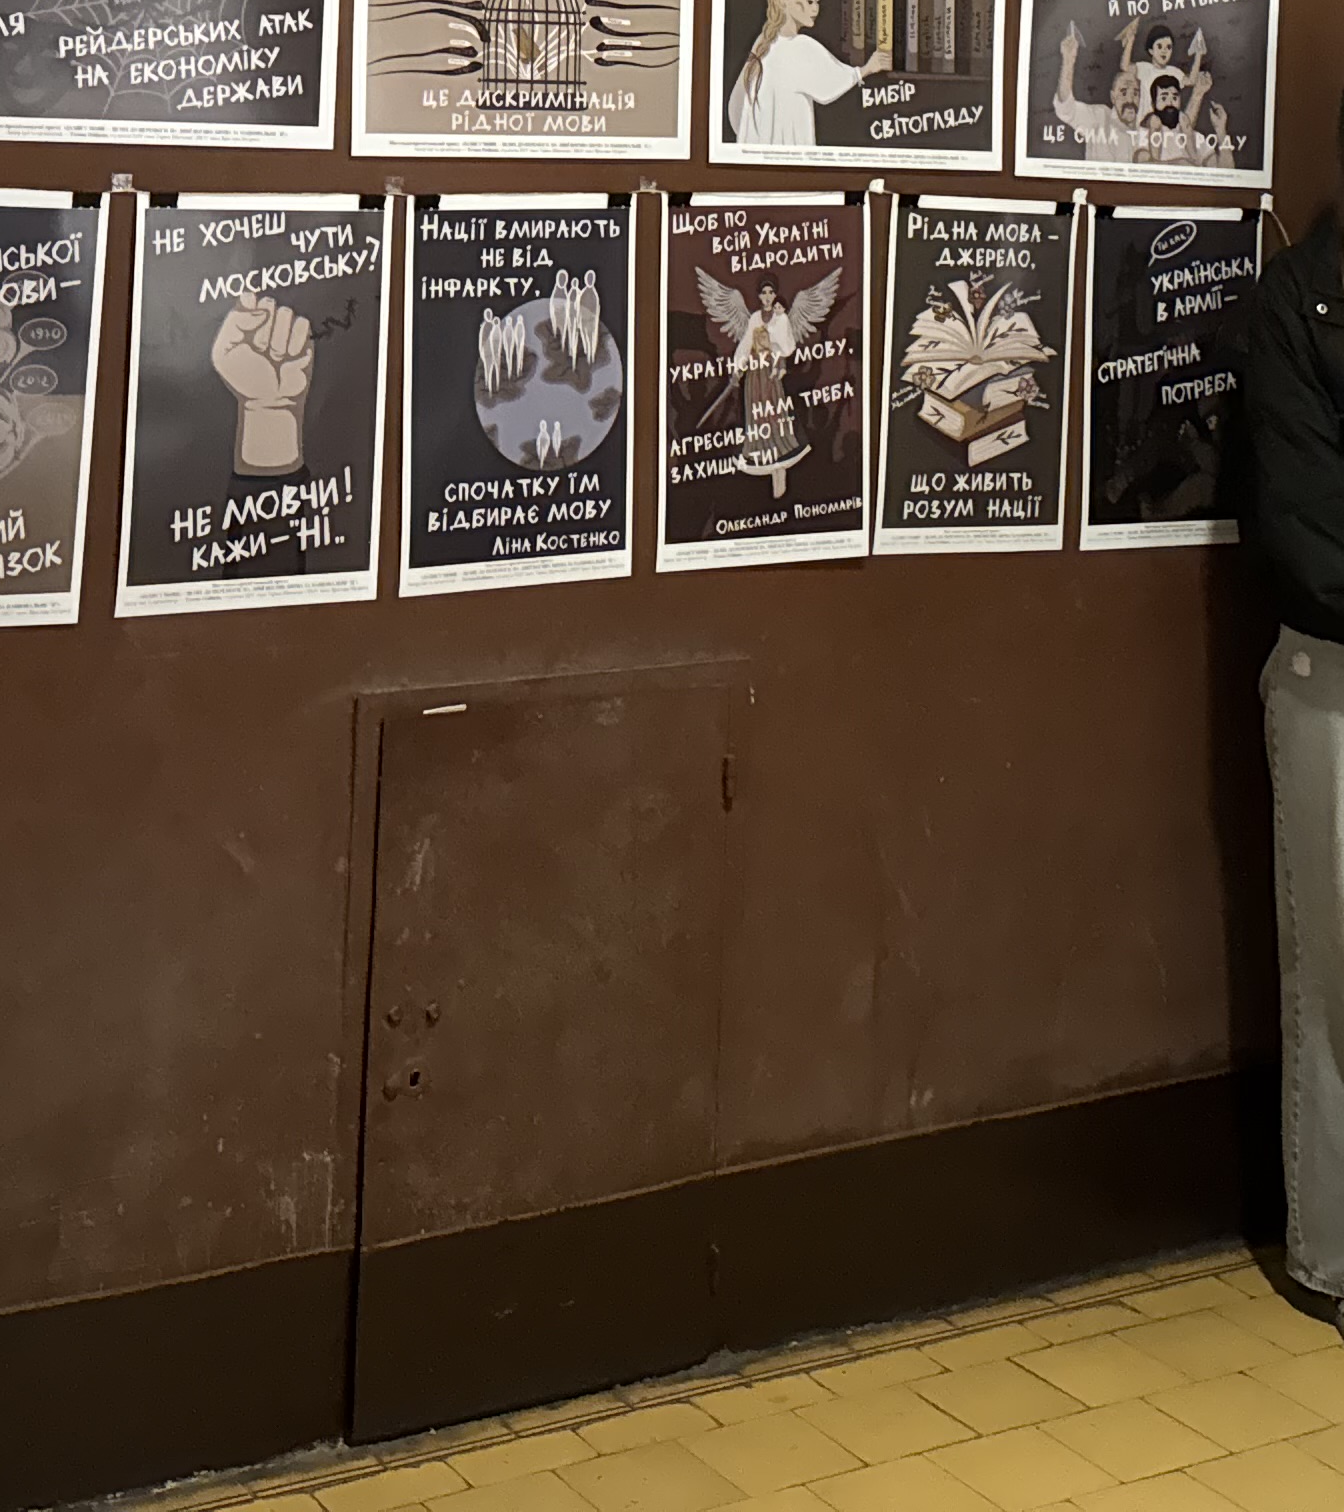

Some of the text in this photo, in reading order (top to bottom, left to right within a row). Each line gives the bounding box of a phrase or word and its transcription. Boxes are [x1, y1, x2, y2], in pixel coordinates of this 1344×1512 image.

[57, 8, 314, 60] РЕЙДЕРСЬКИХ АТАК
[129, 44, 280, 85] ЕКОНОМІКУ
[175, 75, 304, 111] ДЕРЖАВИ
[455, 89, 635, 110] ДИСКРИМІНАЦІЯ
[861, 82, 916, 108] ВИБІР
[451, 110, 607, 132] РІДНОЇ МОВИ
[869, 105, 983, 140] СВІТОГЛЯДУ
[1043, 125, 1247, 151] ЦЕ СИЛА ТВОГО РОДУ
[199, 212, 354, 253] ХОЧЕШ ЧУТИ
[495, 218, 621, 240] ВМИРАЮТЬ
[725, 211, 748, 228] ПО
[985, 222, 1042, 242] МОВА
[512, 244, 554, 268] ВІД
[712, 228, 751, 254] ВСІЙ
[730, 241, 843, 274] ВІДРОДИТИ
[198, 236, 381, 303] МОСКОВСЬКУ?
[1151, 256, 1255, 295] УКРАЇНСЬКА
[1173, 285, 1223, 318] АРМІЇ
[670, 351, 781, 384] УКРАЇНСЬКУ
[1097, 342, 1201, 384] СТРАТЕГІЧНА
[752, 381, 854, 420] НАМ ТРЕБА
[1162, 371, 1238, 405] ПОТРЕБА
[670, 417, 795, 457] АГРЕСИВНО ЇЇ
[444, 475, 559, 504] СПОЧАТКУ
[953, 472, 1033, 492] ЖИВИТЬ
[427, 499, 612, 534] ВІДБИРАЄ МОВУ
[903, 496, 974, 521] РОЗУМ
[191, 532, 267, 571] КАЖИ
